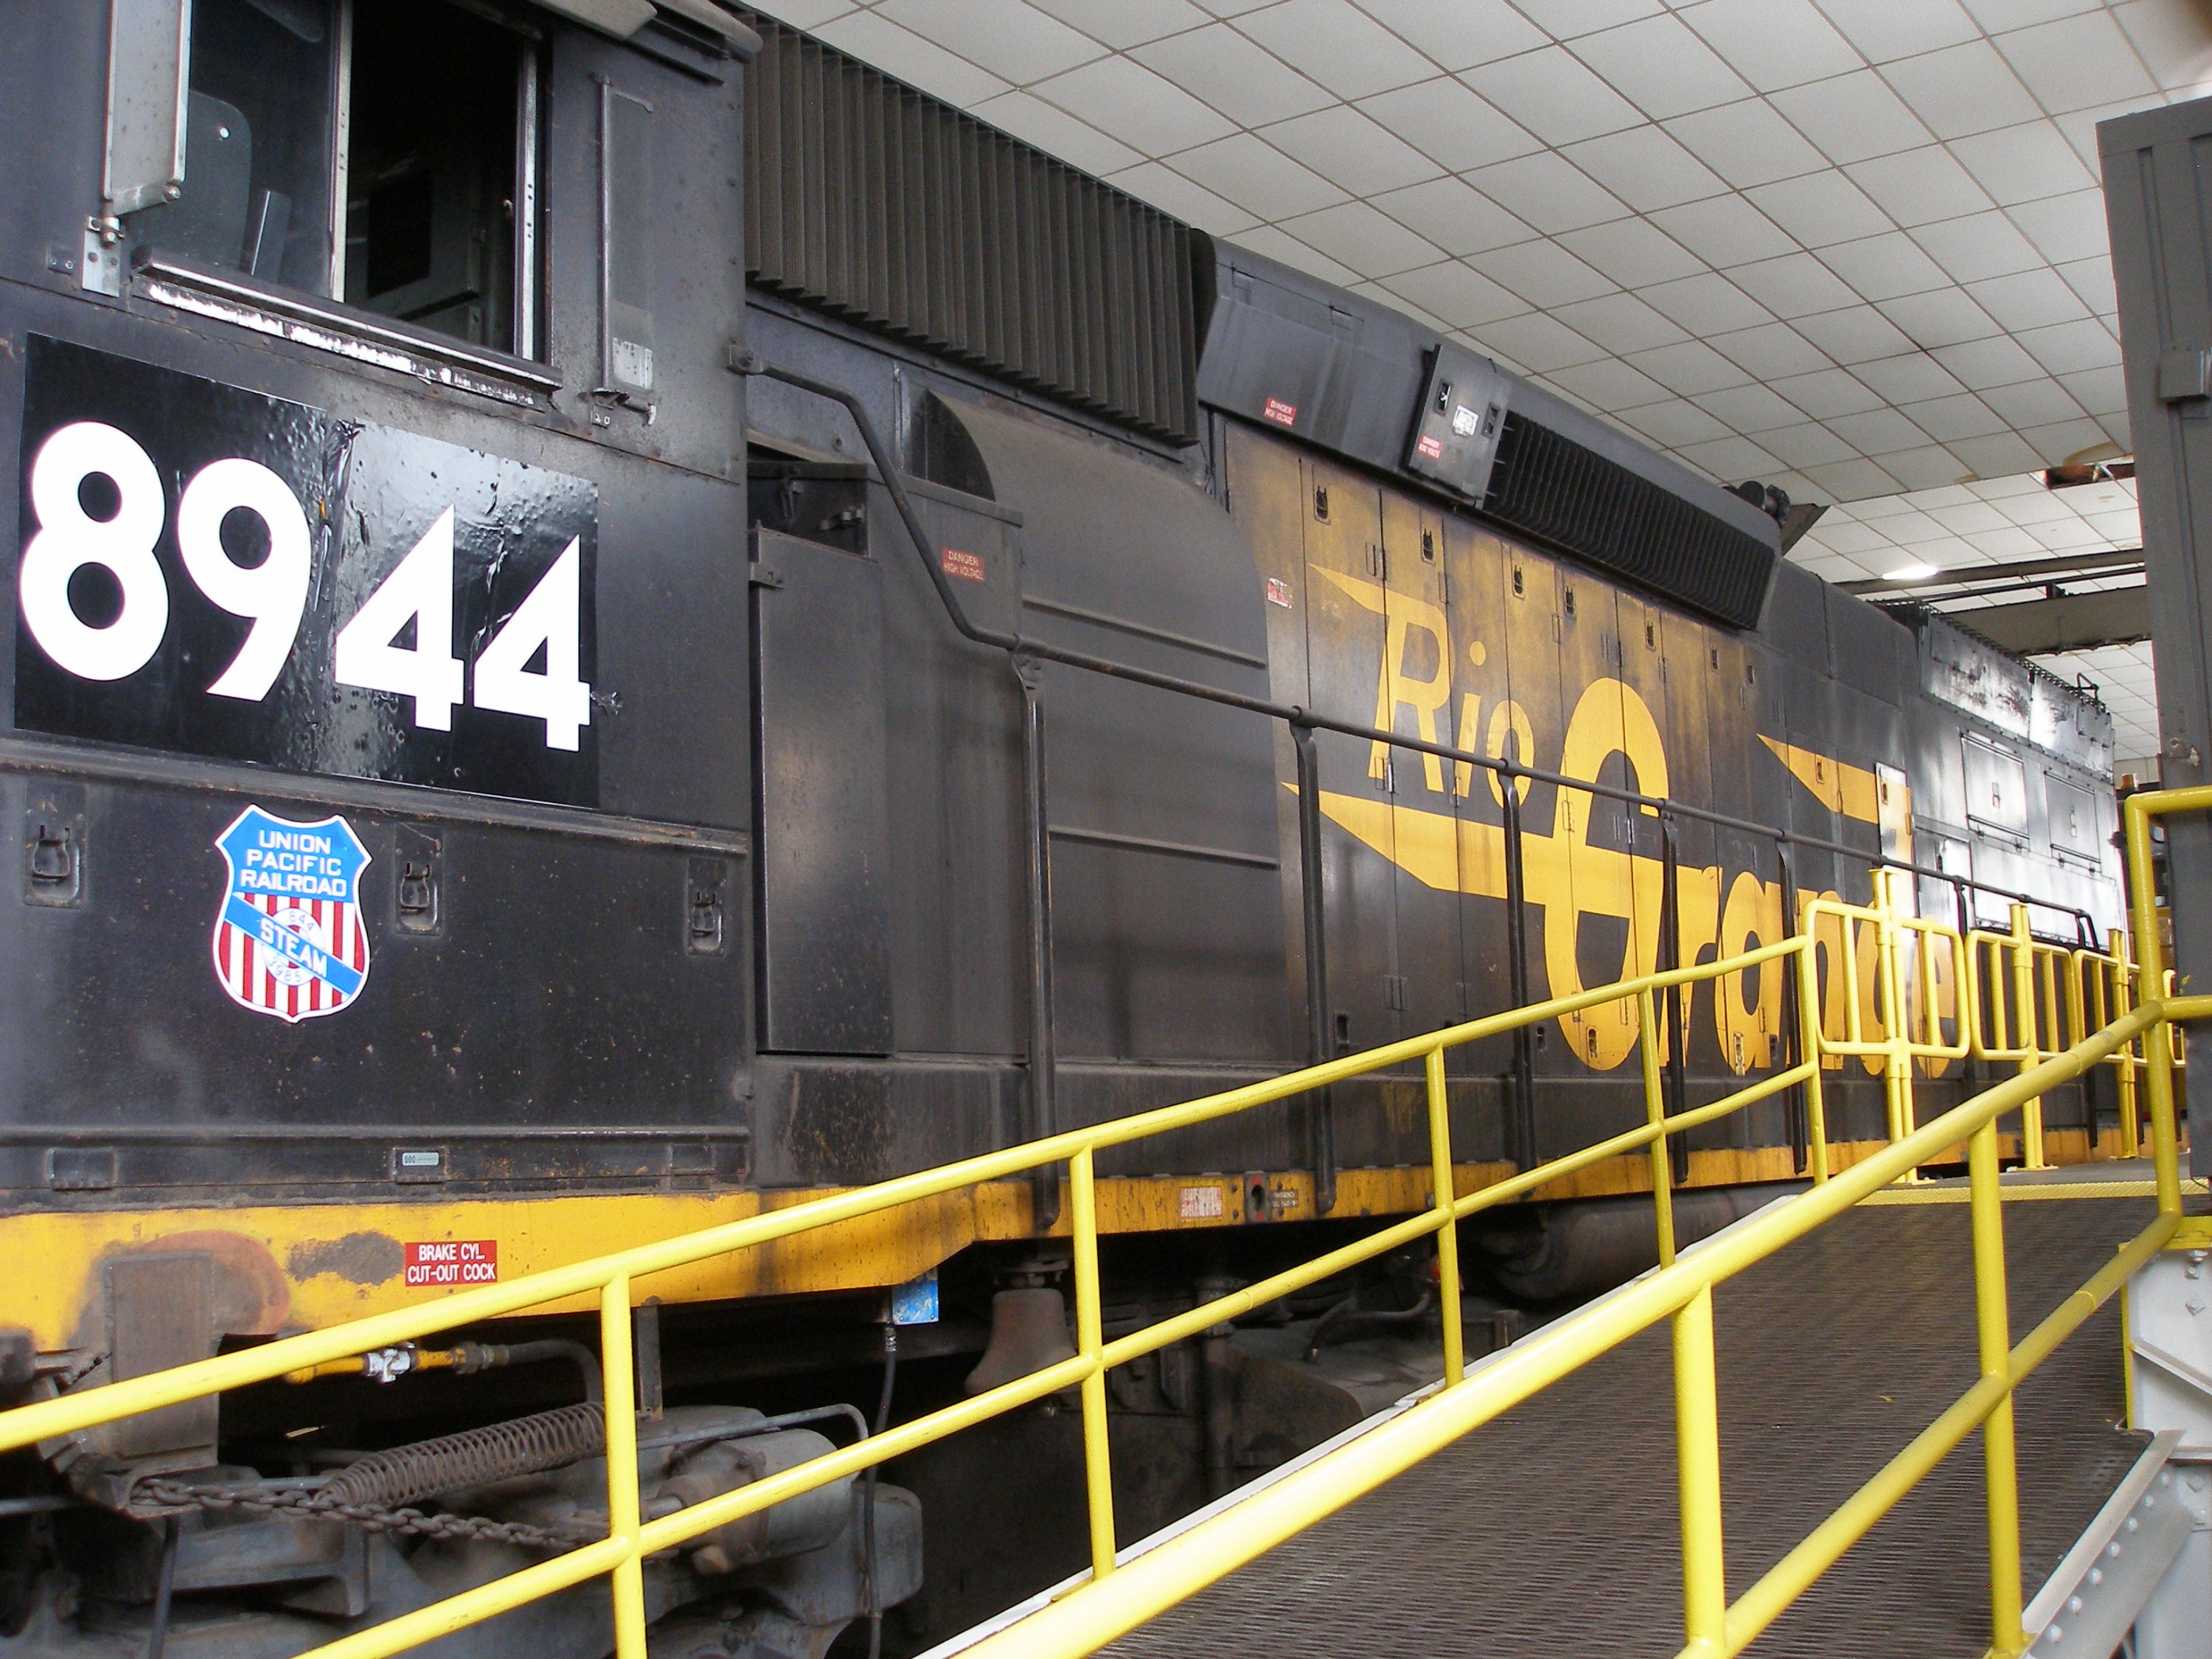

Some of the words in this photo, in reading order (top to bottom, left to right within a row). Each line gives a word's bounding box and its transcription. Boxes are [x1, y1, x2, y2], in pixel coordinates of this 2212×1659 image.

[1270, 400, 1292, 414] DANGER
[948, 550, 979, 567] DANGER
[18, 422, 591, 752] 8944
[1309, 563, 1534, 807] Rio
[259, 830, 331, 855] UNION
[246, 849, 342, 877] PACIFIC
[240, 869, 347, 897] RAILROAD
[289, 910, 313, 931] 844
[260, 917, 328, 978] STEAM
[268, 957, 302, 983] 3985
[418, 1244, 457, 1262] BRAKE
[407, 1264, 460, 1283] CUT-OUT
[462, 1262, 496, 1281] COCK
